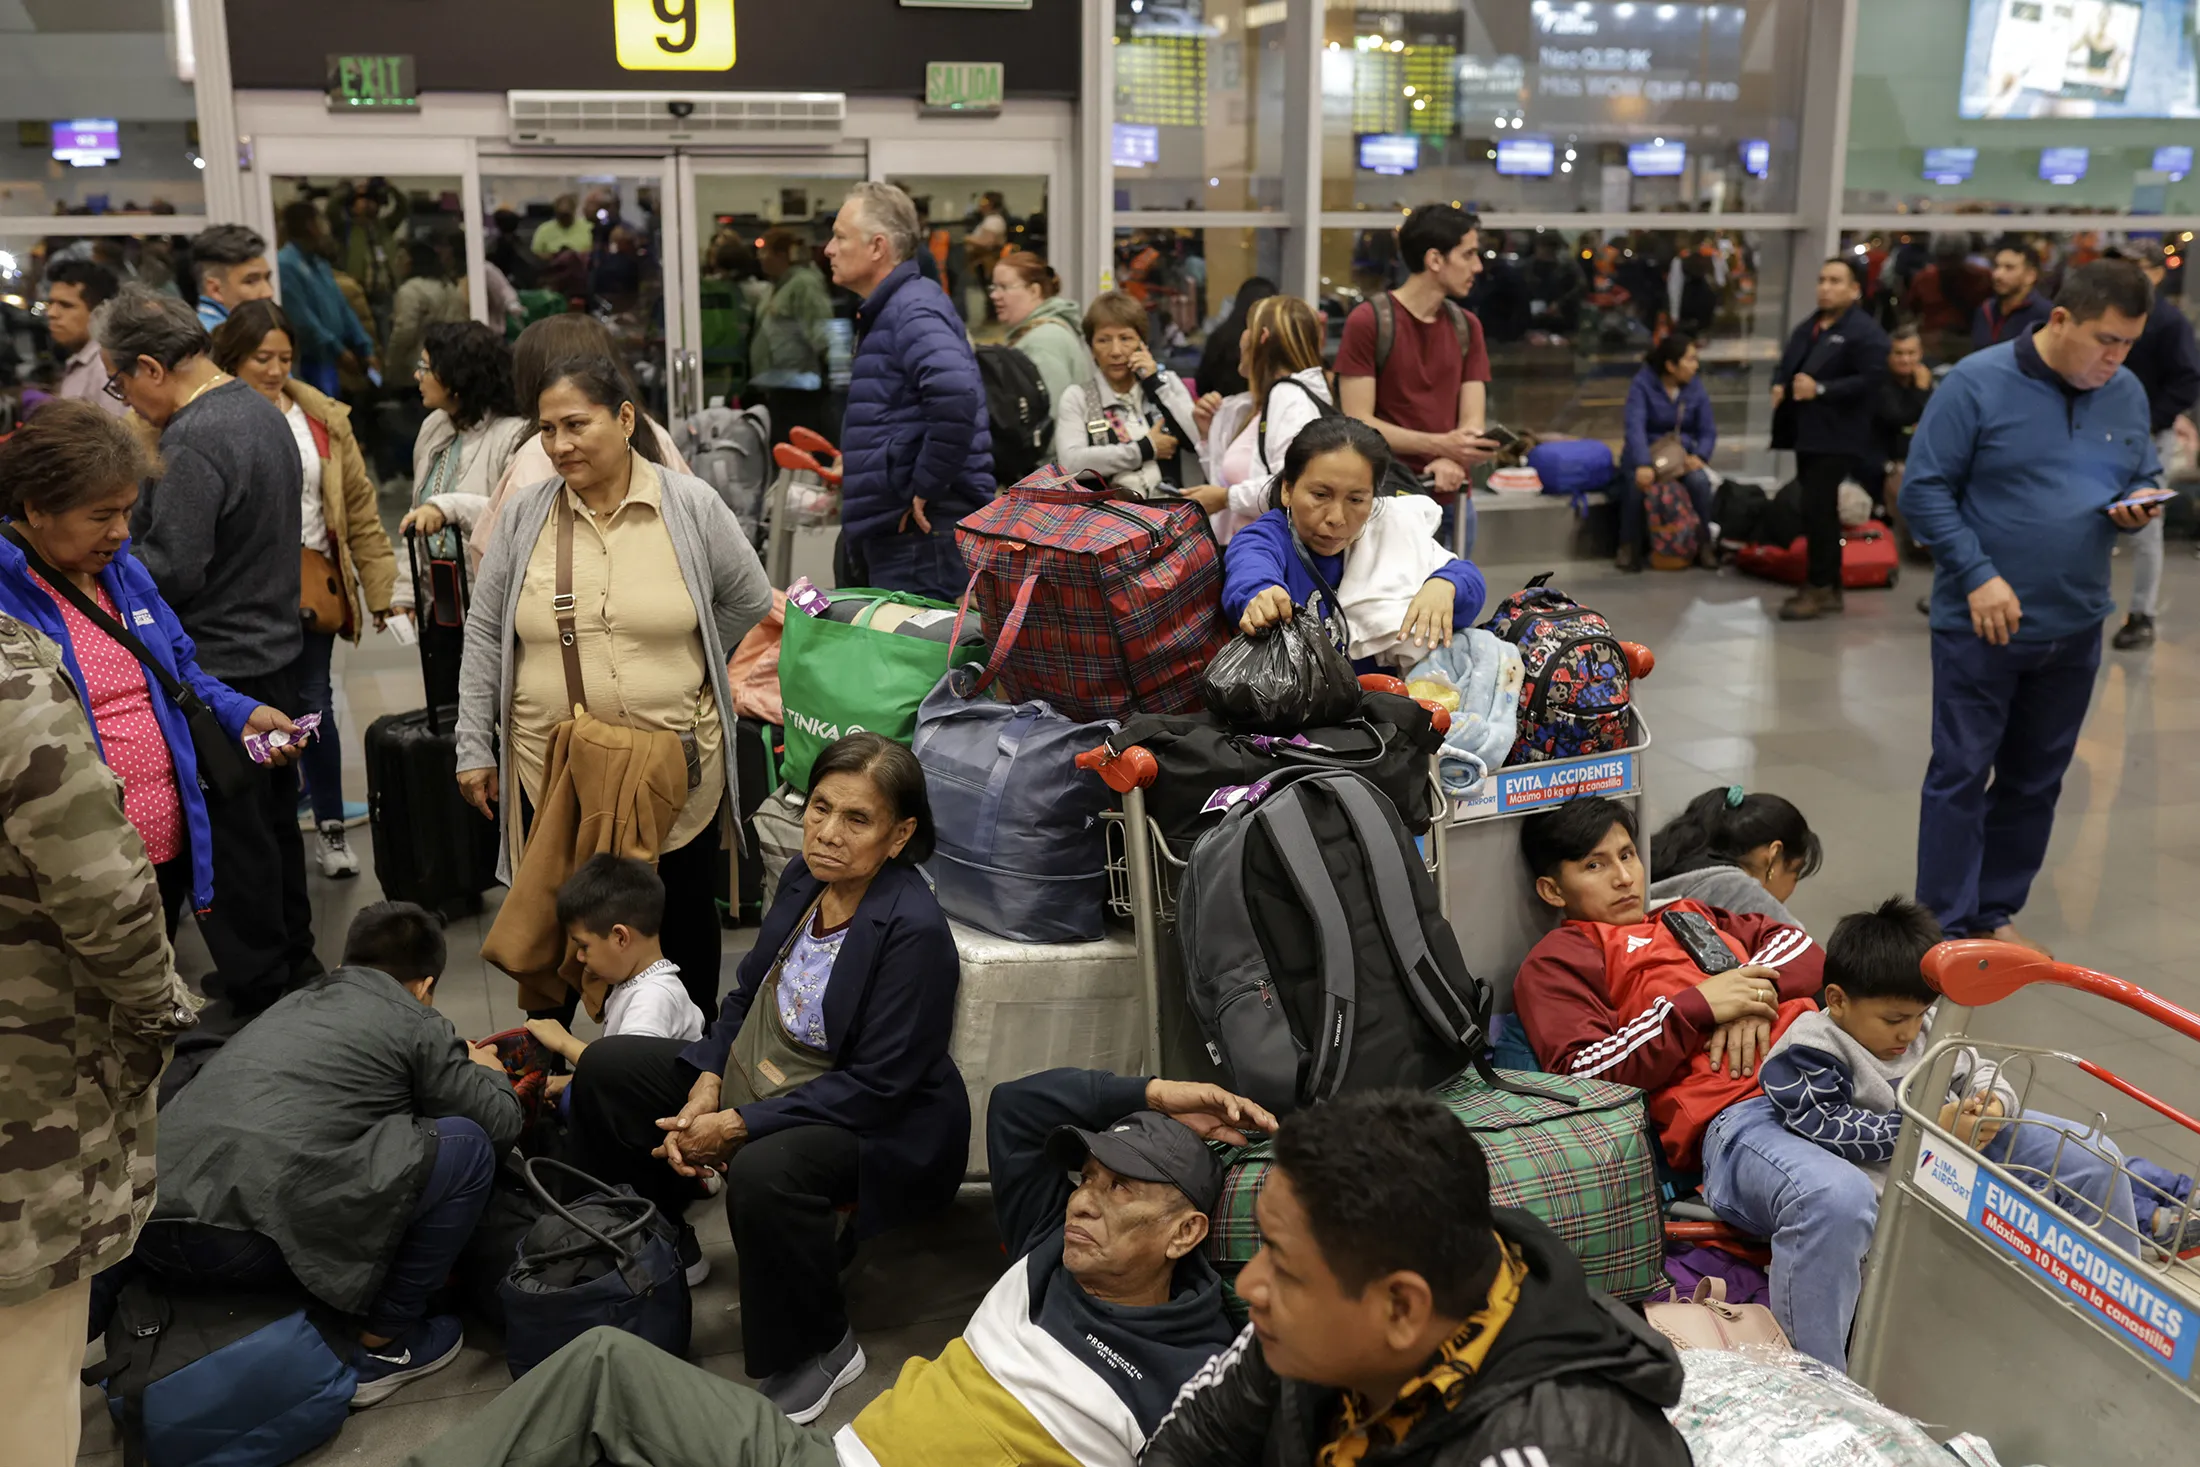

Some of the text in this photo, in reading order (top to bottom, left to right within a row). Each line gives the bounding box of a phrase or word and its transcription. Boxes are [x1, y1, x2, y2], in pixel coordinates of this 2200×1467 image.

[339, 56, 403, 97] EXIT
[930, 66, 999, 102] SALIDA
[1506, 762, 1624, 794] EVITA ACCIDENTES
[1509, 791, 1542, 805] Máximo
[1543, 788, 1553, 798] 10
[1553, 787, 1564, 799] kg
[1565, 786, 1576, 795] en
[1586, 778, 1622, 791] canastilla
[1467, 795, 1497, 807] AIRPORT
[1931, 1168, 1970, 1200] AIRPORT
[1934, 1156, 1957, 1180] LIMA
[1985, 1181, 2183, 1338] EVITA ACCIDENTES
[1986, 1213, 2172, 1358] Máximo 10 kg en la canastilla
